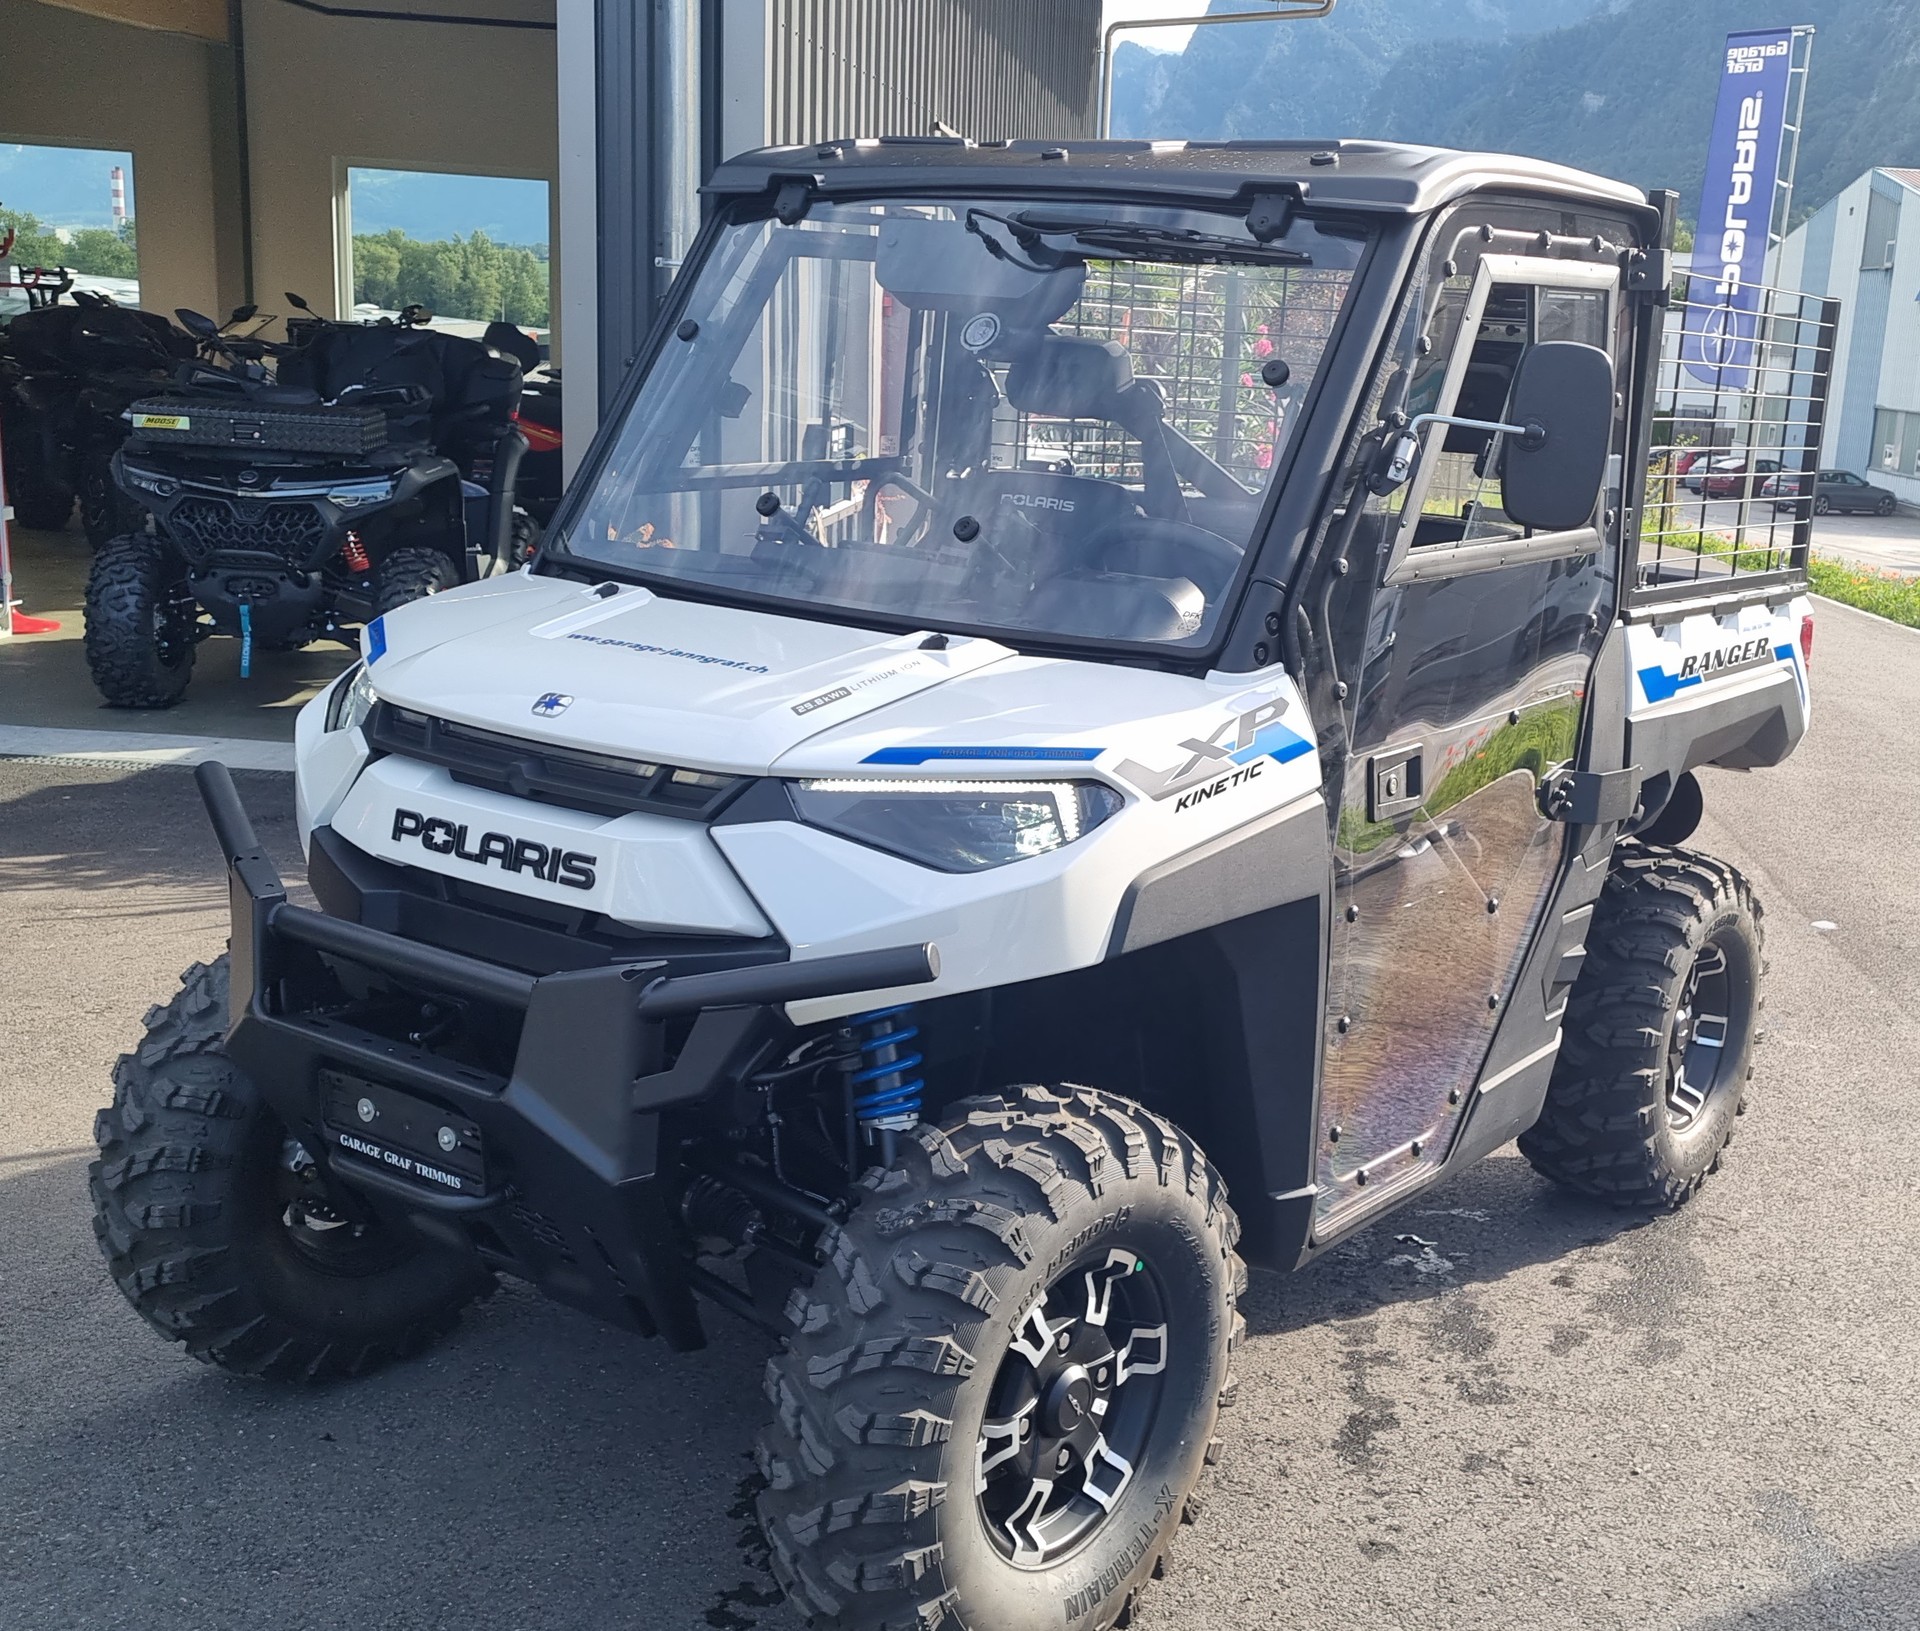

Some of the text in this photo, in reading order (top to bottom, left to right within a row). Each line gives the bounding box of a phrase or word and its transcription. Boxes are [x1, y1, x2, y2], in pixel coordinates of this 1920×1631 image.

[145, 417, 176, 425] MOOSE
[1000, 493, 1075, 512] POLARIS
[566, 633, 770, 674] www.garage-janngraf.ch
[1680, 637, 1769, 678] RANGER
[795, 660, 921, 714] 29.8kWh LITHIUM ION
[1170, 697, 1290, 783] XP
[1175, 761, 1265, 814] KINETIC
[391, 808, 598, 891] POLARIS
[340, 1134, 462, 1189] GARAGE GRAF TRIMMIS
[1063, 1482, 1179, 1624] X-TERRAIN
